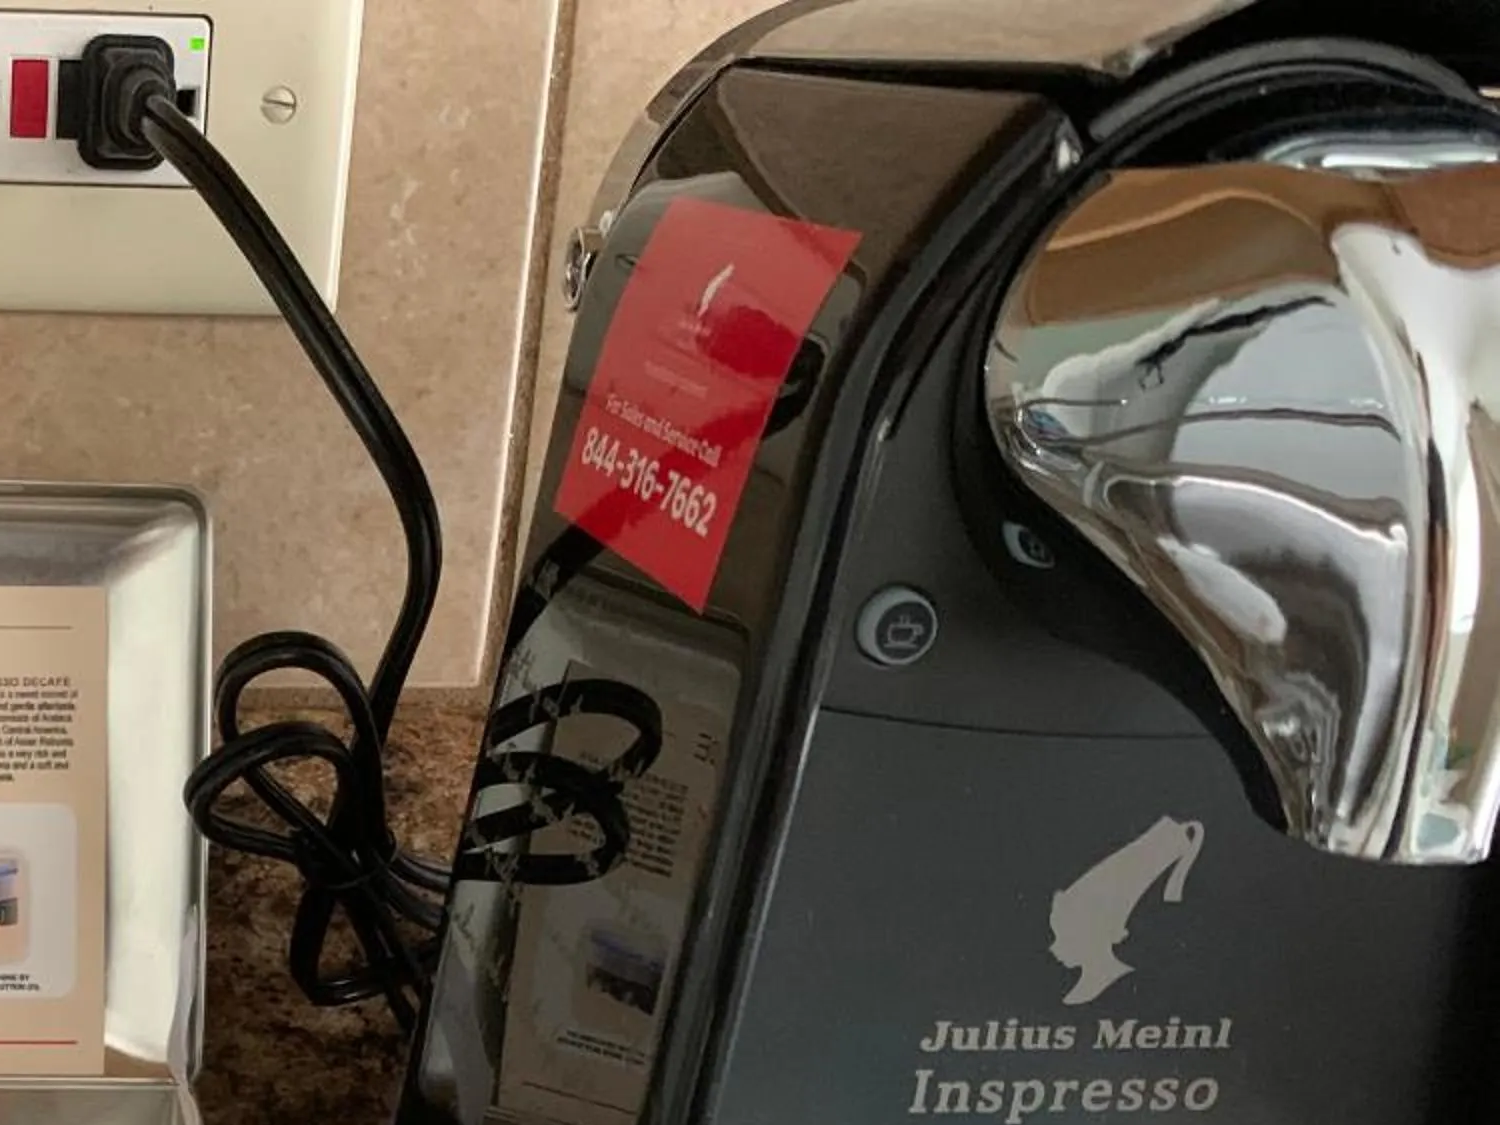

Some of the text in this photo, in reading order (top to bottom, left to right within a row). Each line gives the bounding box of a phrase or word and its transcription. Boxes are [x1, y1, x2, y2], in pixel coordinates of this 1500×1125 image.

[582, 427, 719, 539] 844-316-7662
[919, 1016, 1233, 1052] Julius Meinl
[907, 1069, 1220, 1125] Inspresso
